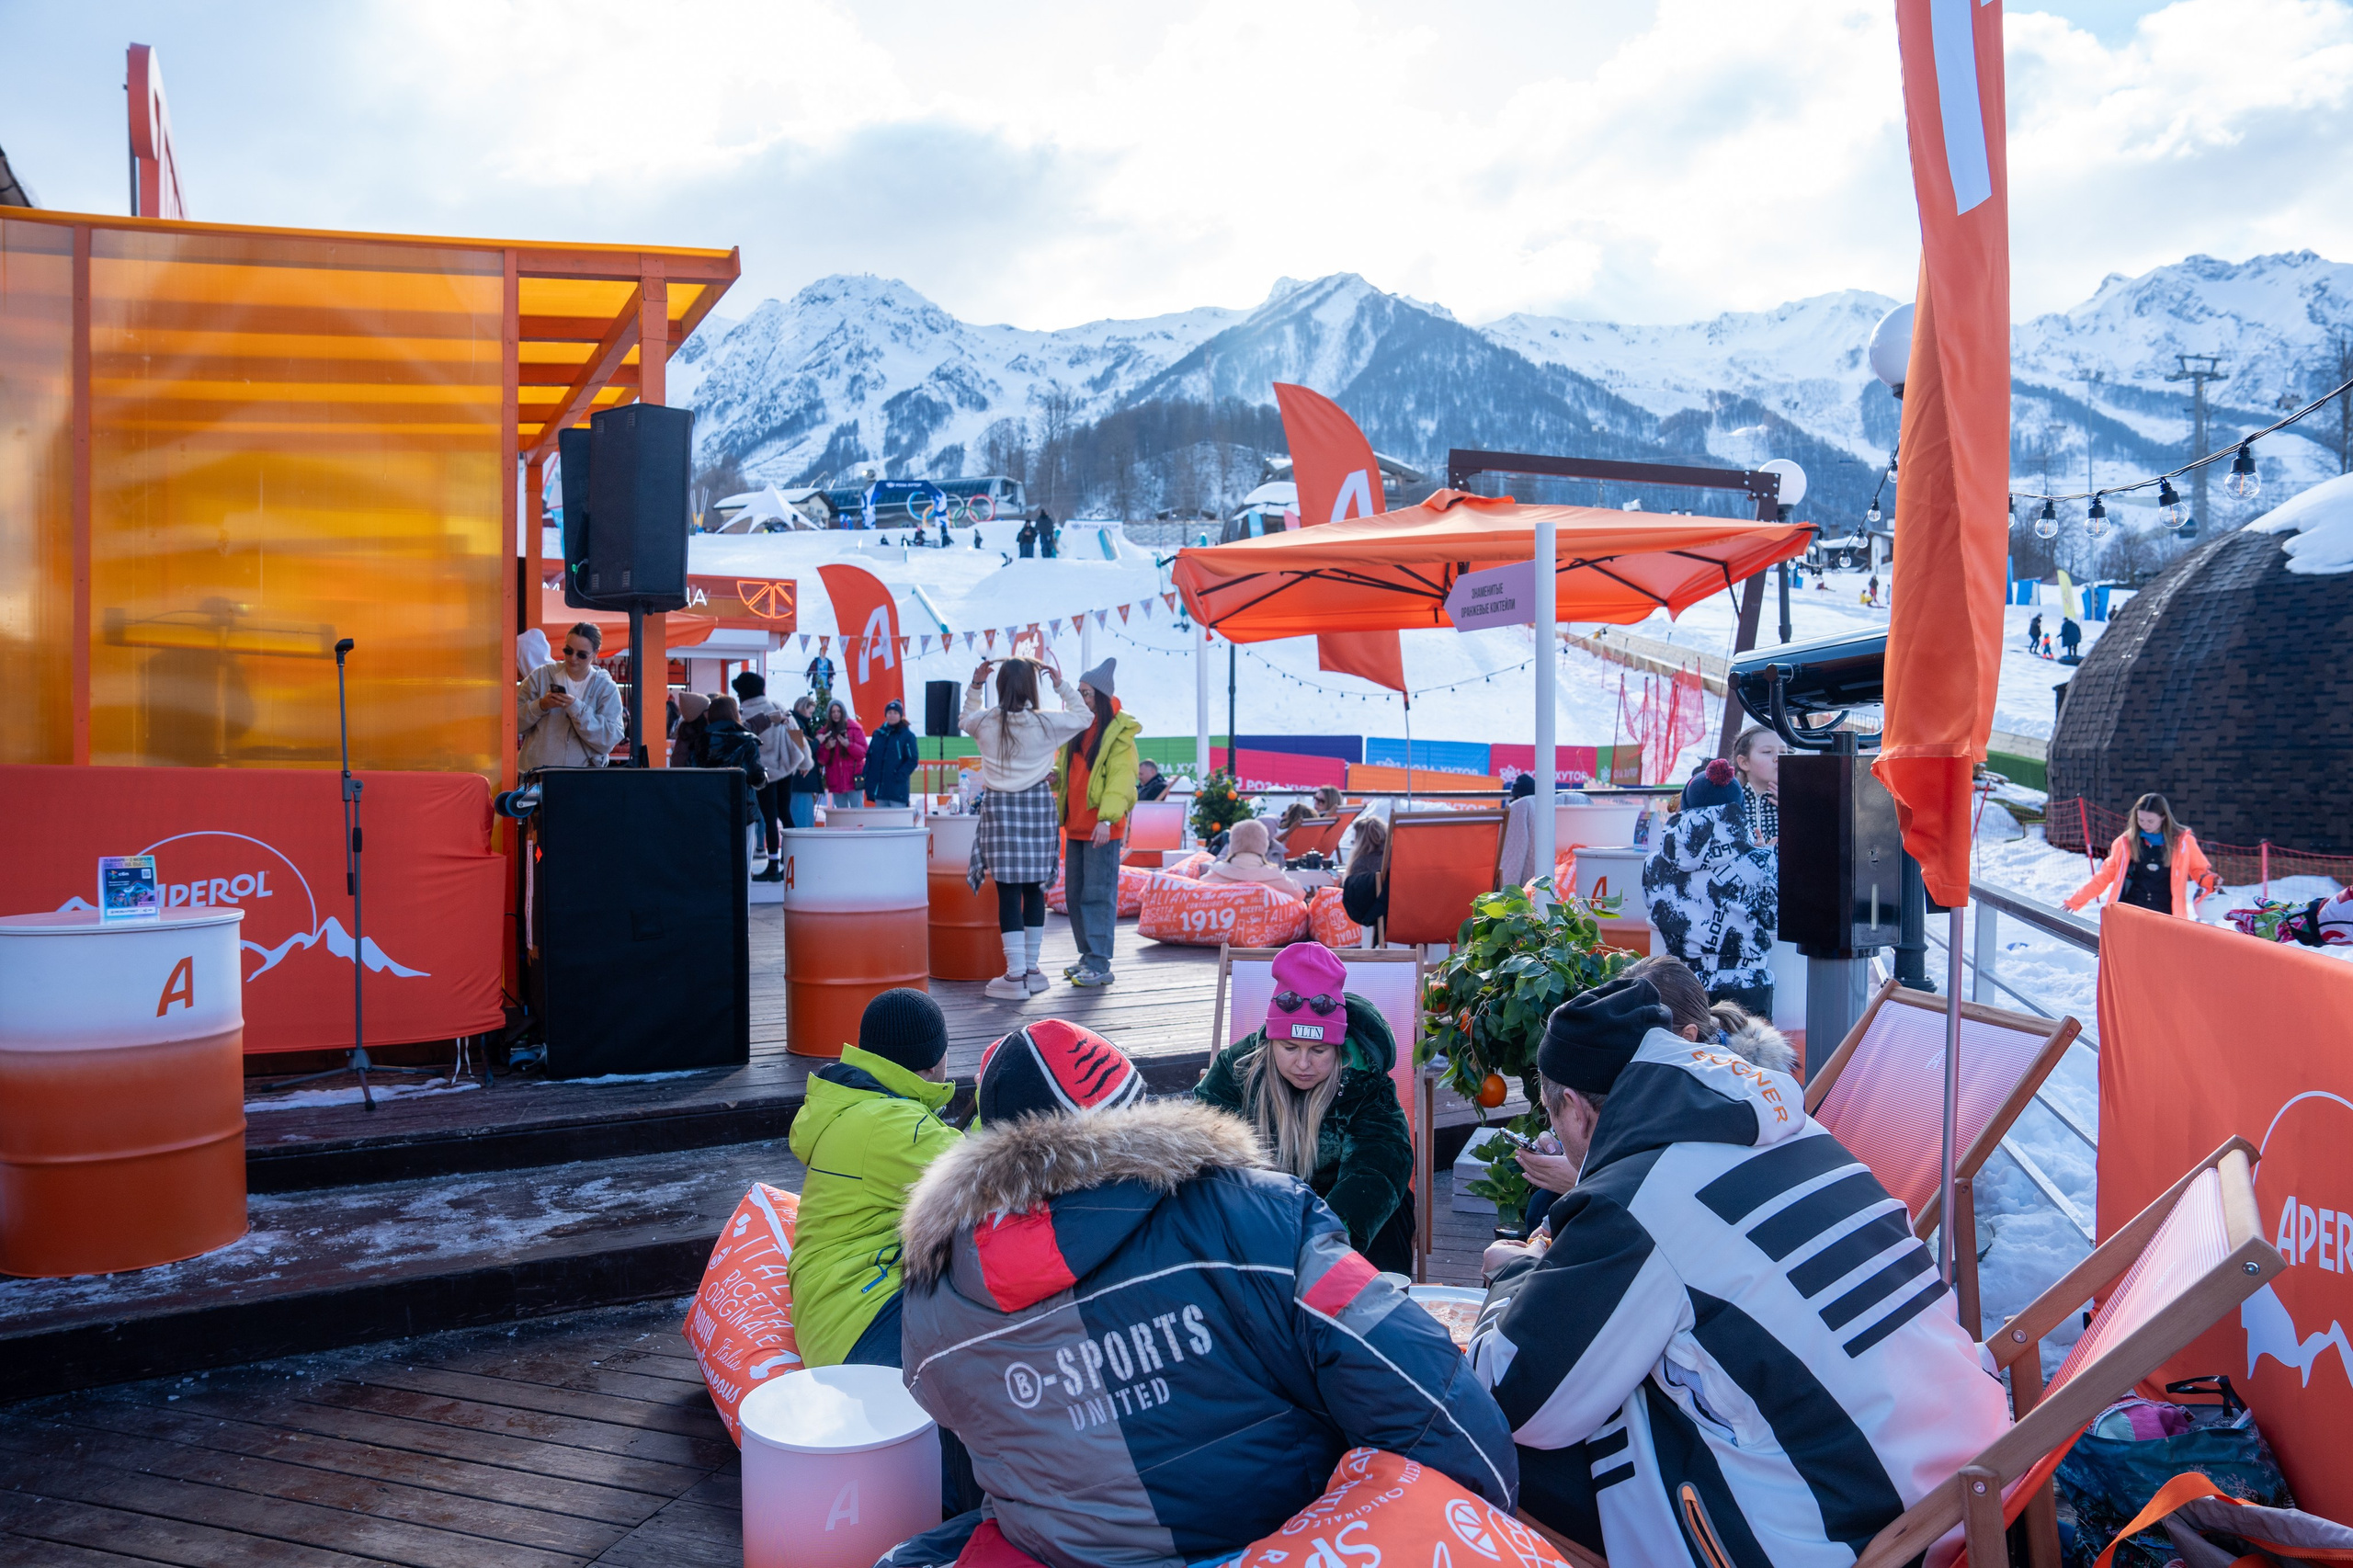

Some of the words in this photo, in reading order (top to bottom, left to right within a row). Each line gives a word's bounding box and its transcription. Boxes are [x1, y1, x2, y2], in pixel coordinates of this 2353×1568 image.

[686, 588, 708, 608] А
[1461, 603, 1490, 619] ОРАНЖЕВЫЕ
[1490, 597, 1516, 613] КОКТЕЙЛИ
[1471, 583, 1504, 599] ЗНАМЕНИТЫЕ
[858, 604, 895, 686] A
[1157, 763, 1173, 774] ЗА
[785, 856, 795, 892] A
[1589, 876, 1607, 911] A
[1179, 907, 1236, 932] 1919
[1335, 926, 1361, 944] ITUAL
[156, 956, 194, 1017] A
[1294, 1025, 1323, 1039] VLTN
[2276, 1196, 2353, 1275] APER
[734, 1234, 792, 1305] ITAL
[705, 1281, 783, 1348] ORIGINALE
[722, 1268, 793, 1329] RICETTA
[694, 1302, 718, 1348] PADOVA
[712, 1337, 745, 1373] Italia
[1067, 1377, 1171, 1431] UNITED
[1397, 1457, 1422, 1484] ICETTA
[825, 1479, 860, 1532] A
[1314, 1487, 1404, 1528] ORIGINALE
